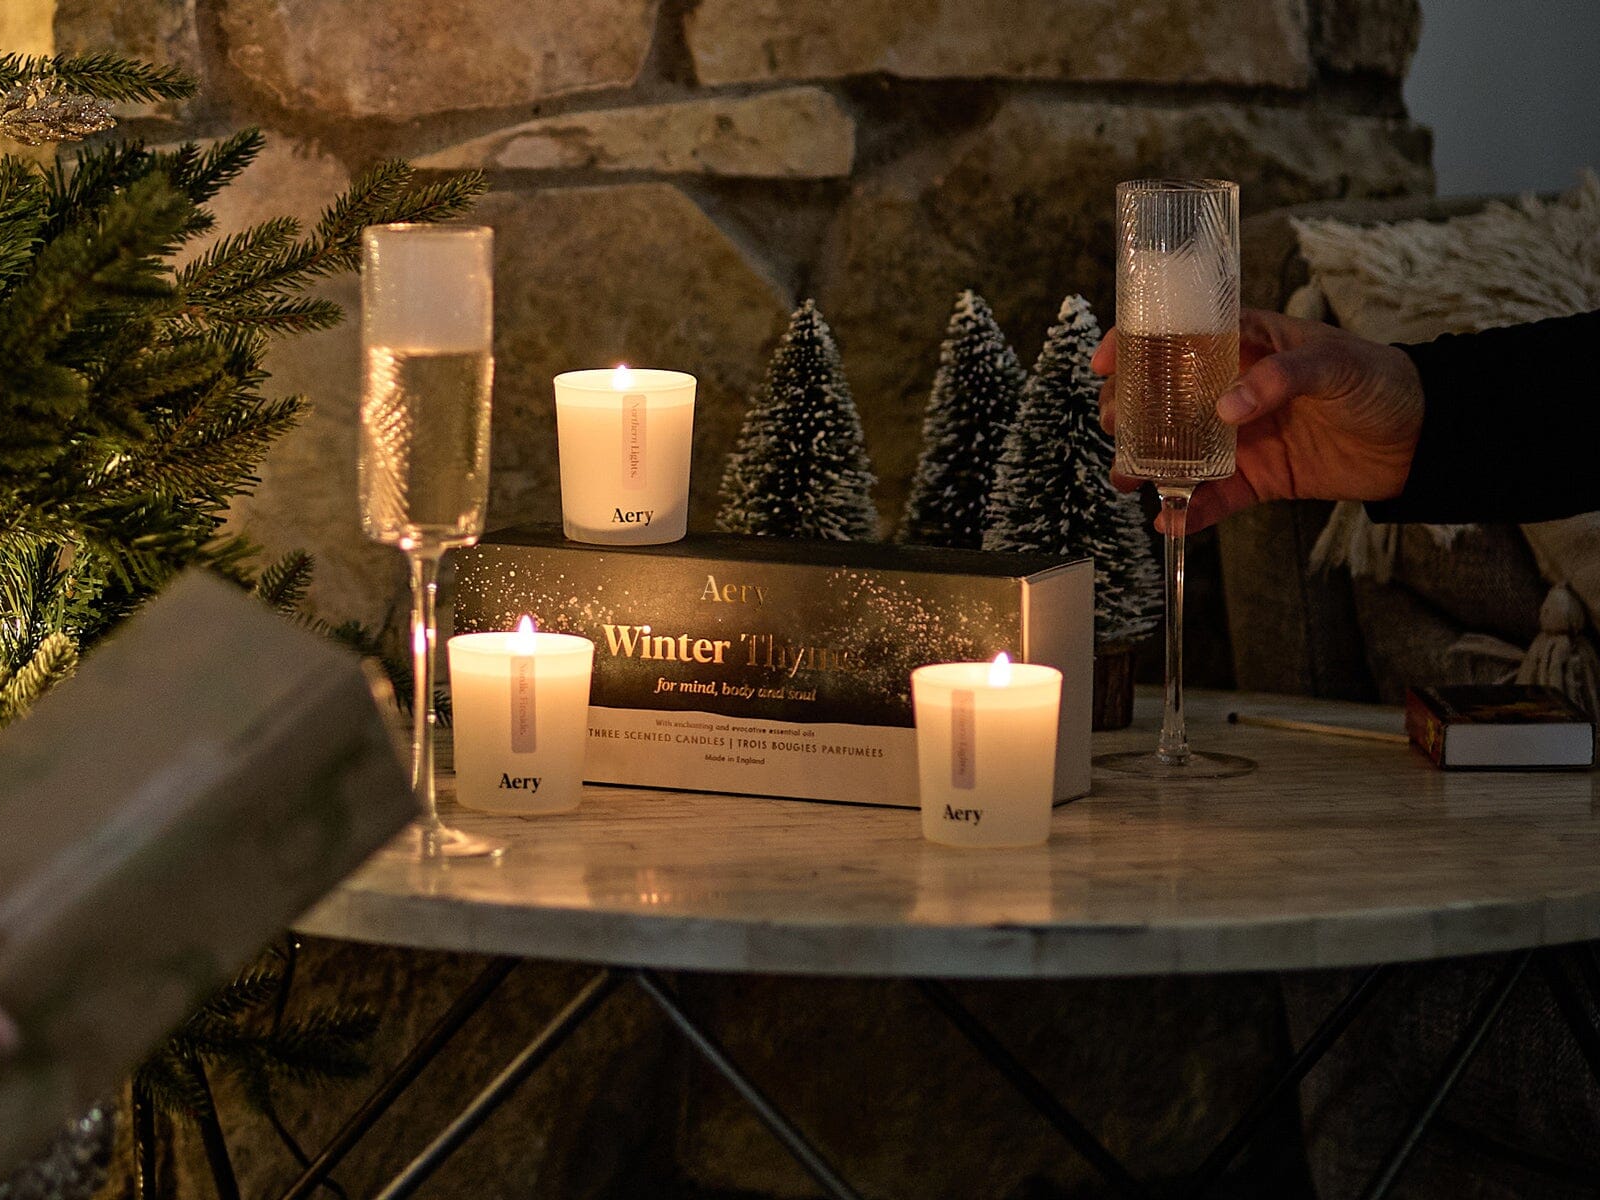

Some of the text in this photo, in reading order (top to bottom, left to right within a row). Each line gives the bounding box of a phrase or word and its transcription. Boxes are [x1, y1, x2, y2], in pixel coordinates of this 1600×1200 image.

[611, 508, 654, 526] Aery
[700, 575, 769, 611] Aery
[603, 624, 731, 664] Winter
[654, 677, 817, 701] for mind, body and soul
[715, 723, 730, 732] and
[731, 725, 767, 734] evocative
[768, 728, 801, 736] essential
[802, 730, 815, 738] oils
[588, 728, 884, 758] THREE SCENTED CANDLES TROIS BOUGIES PARFUMÉES
[704, 754, 726, 763] Made
[736, 755, 766, 765] England
[499, 772, 542, 793] Aery
[943, 803, 983, 826] Aery
